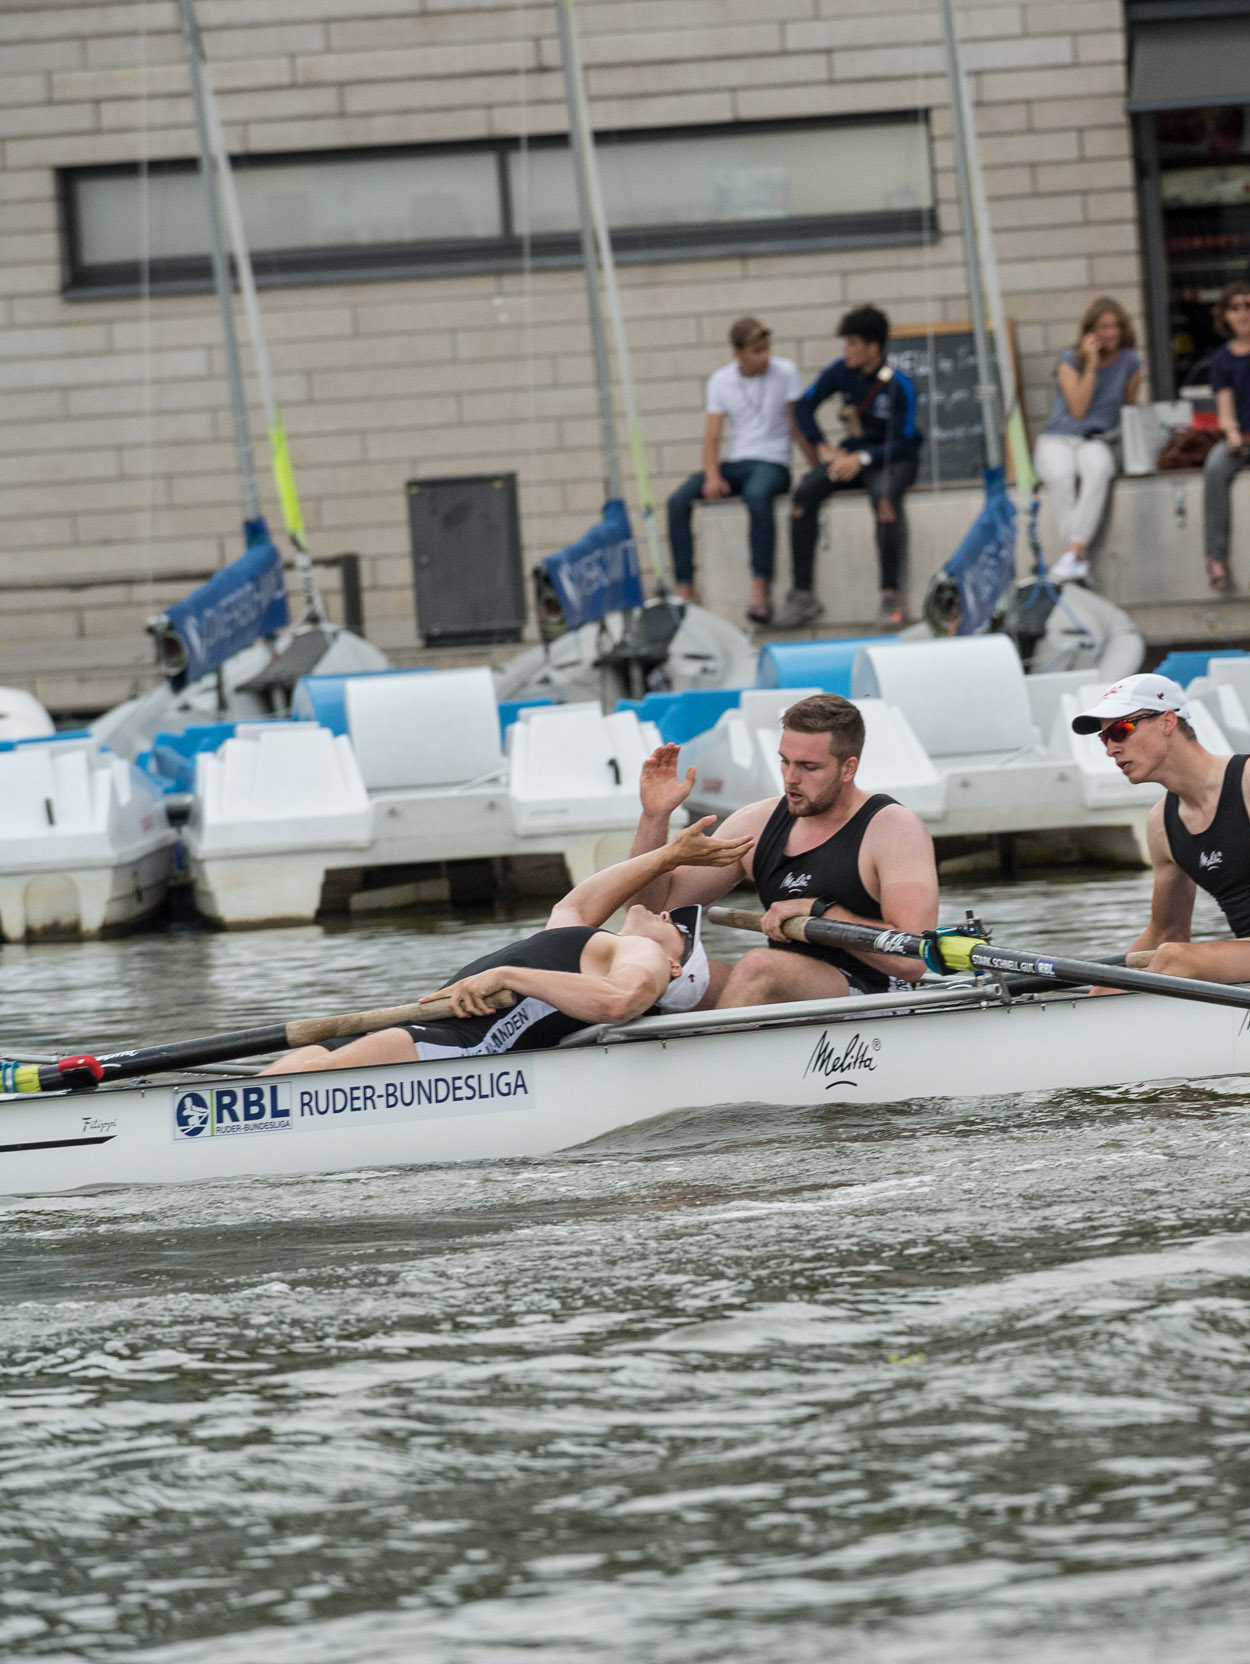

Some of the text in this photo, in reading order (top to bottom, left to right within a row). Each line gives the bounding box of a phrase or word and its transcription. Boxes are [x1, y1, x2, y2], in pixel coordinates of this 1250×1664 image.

[802, 1030, 879, 1079] Melitta
[215, 1085, 290, 1123] RBL
[300, 1070, 528, 1117] RUDER-BUNDESLIGA
[216, 1121, 290, 1134] RUDER-BUNDESLIGA
